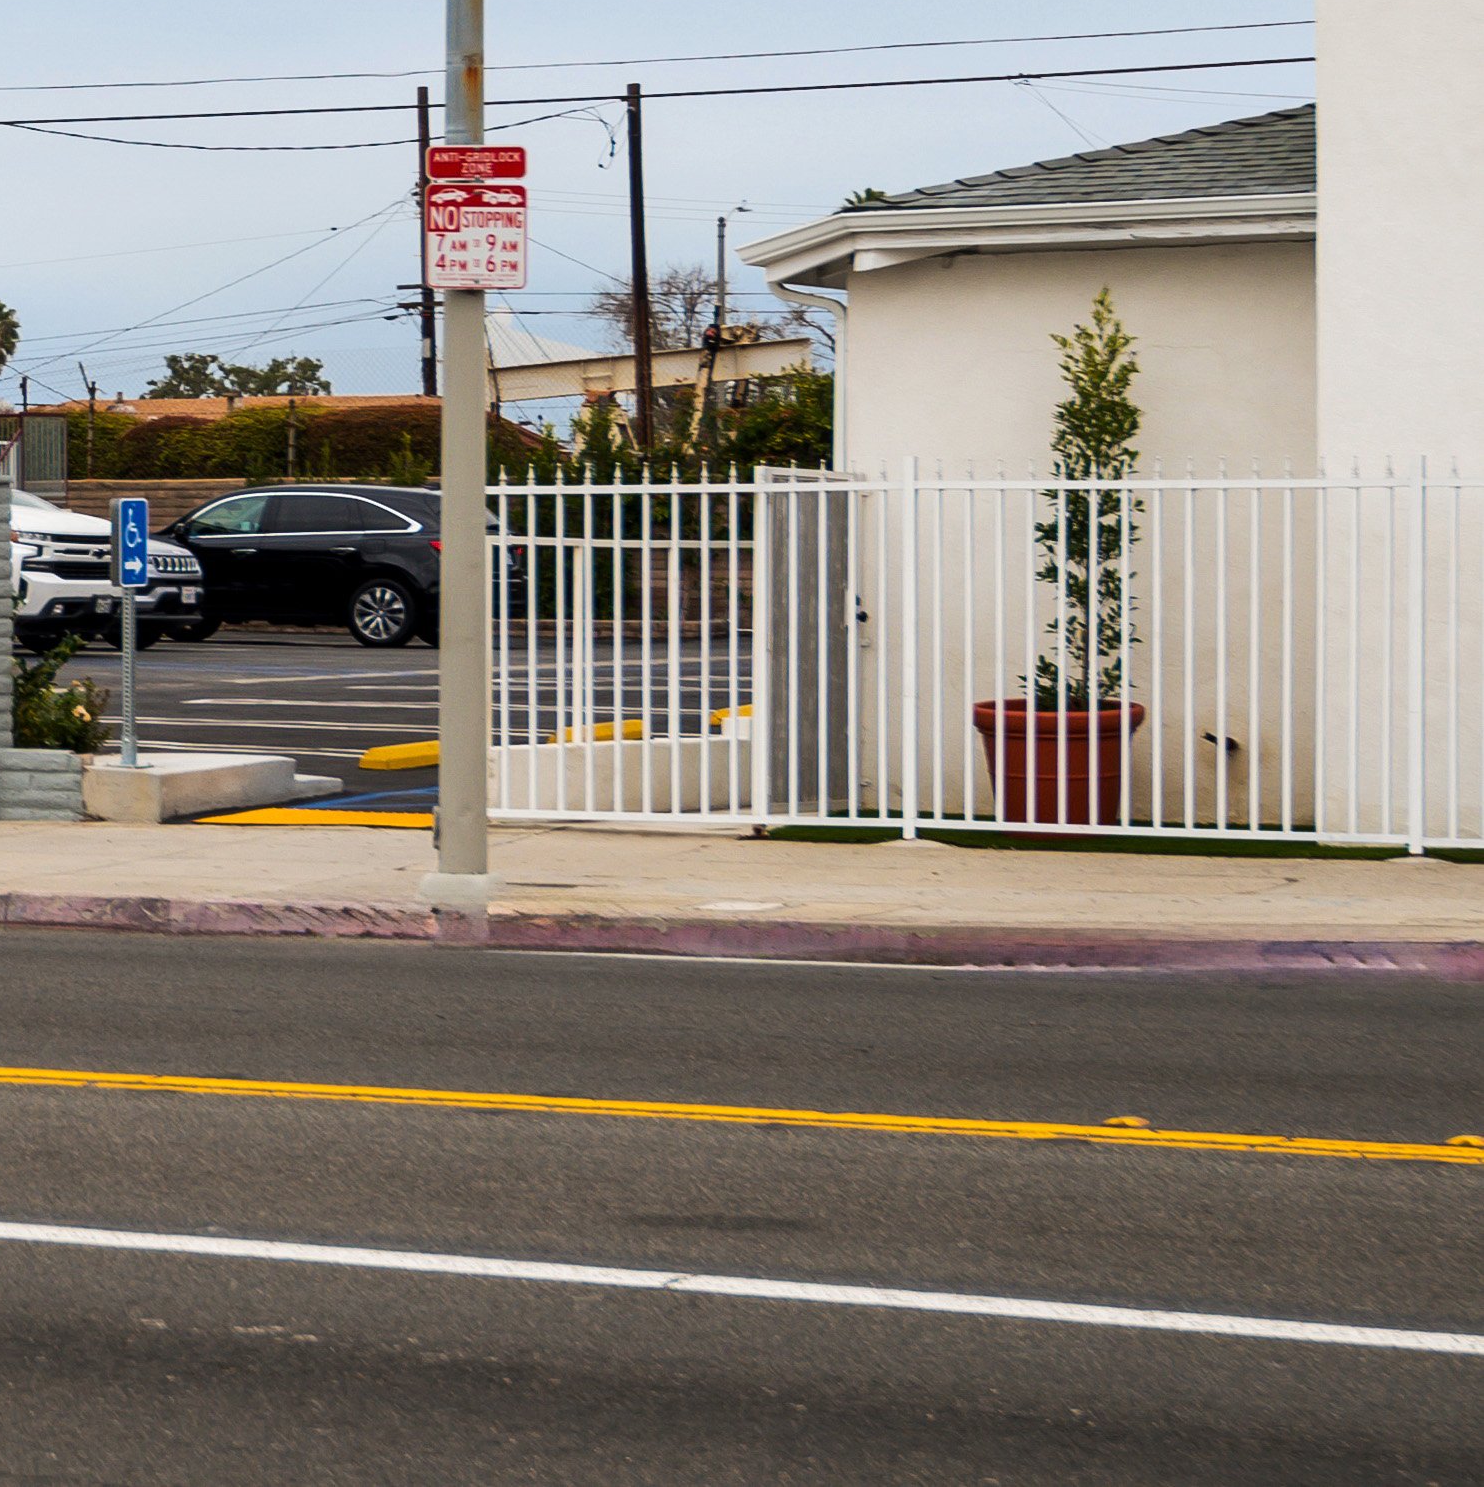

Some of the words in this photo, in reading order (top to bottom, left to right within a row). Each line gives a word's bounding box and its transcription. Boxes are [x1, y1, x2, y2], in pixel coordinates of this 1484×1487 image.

[433, 152, 521, 162] ANTI-GRIDLOCK
[461, 162, 493, 173] ZONE
[430, 206, 459, 230] NO
[462, 211, 523, 228] STOPPING
[435, 233, 446, 251] 7
[450, 239, 468, 252] AM
[486, 234, 496, 252] 9
[500, 240, 519, 252] AM
[435, 254, 446, 271] 4
[450, 259, 468, 271] PM
[486, 255, 496, 272] 6
[500, 260, 519, 272] PM
